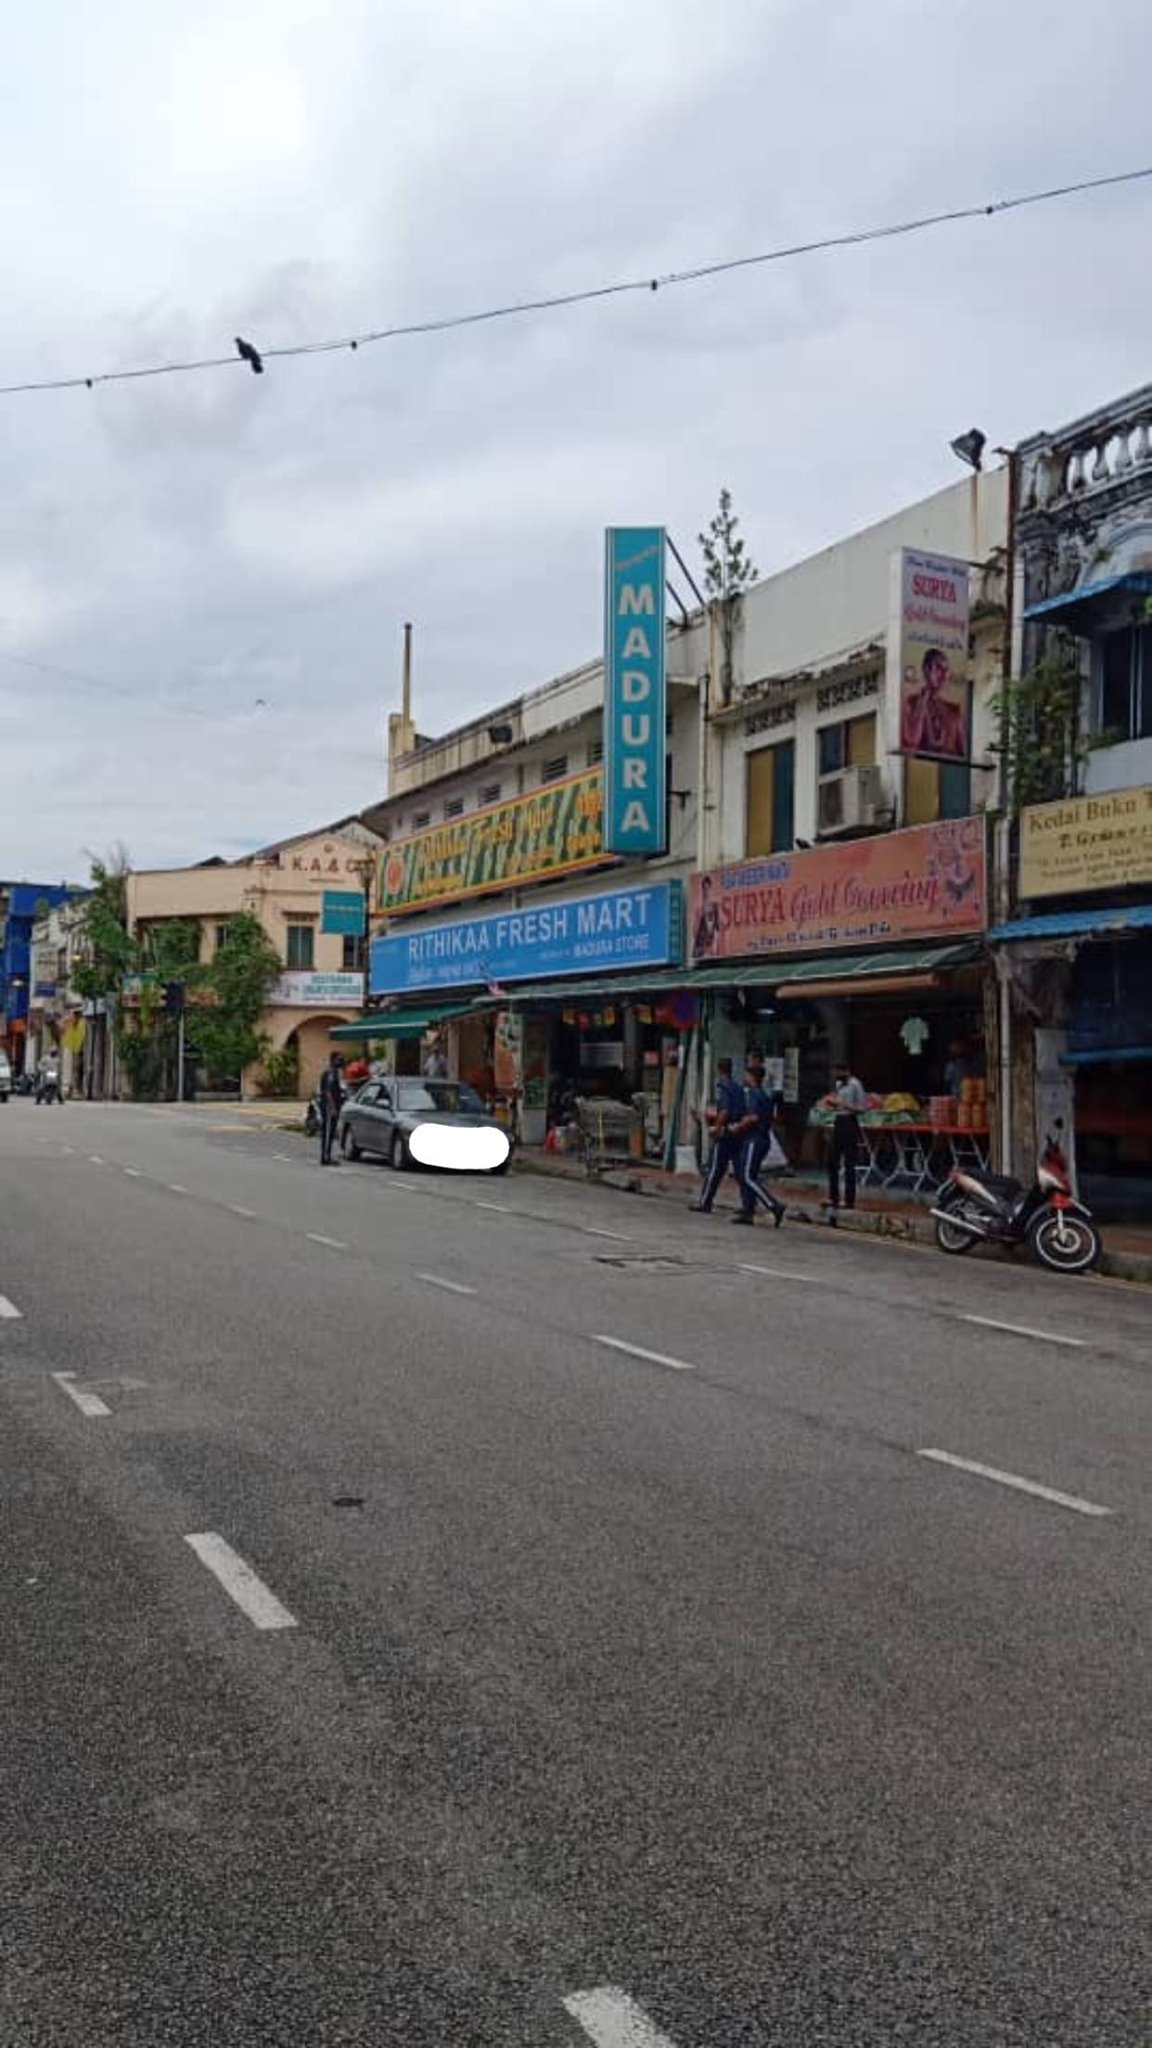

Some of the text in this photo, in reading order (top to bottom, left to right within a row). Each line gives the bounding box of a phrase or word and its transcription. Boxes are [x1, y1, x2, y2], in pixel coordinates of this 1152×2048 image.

[911, 573, 957, 603] SURYA
[617, 582, 655, 833] MADURA
[1028, 805, 1080, 835] Kedai
[1086, 797, 1137, 821] Buku
[408, 924, 489, 962] RITHIKAA
[496, 907, 568, 949] FRESH
[577, 893, 652, 936] MART
[720, 887, 786, 930] SURYA
[614, 933, 651, 952] STORE
